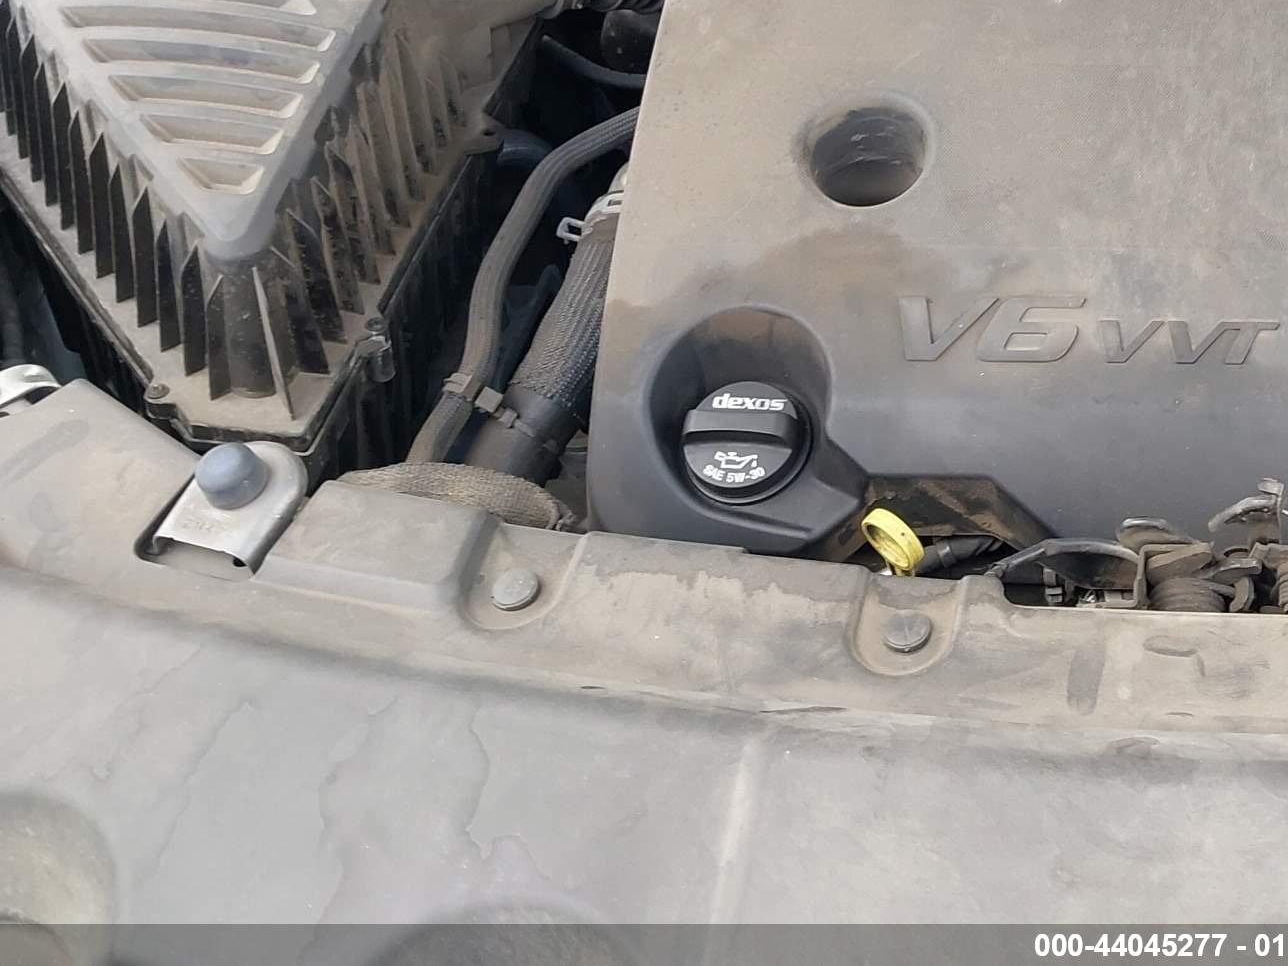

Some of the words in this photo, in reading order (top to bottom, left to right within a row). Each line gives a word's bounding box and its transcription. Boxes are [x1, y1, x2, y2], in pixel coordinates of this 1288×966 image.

[897, 297, 1086, 362] V6
[1098, 319, 1281, 365] VVT
[712, 393, 789, 410] dexos
[703, 464, 725, 481] SAE
[725, 466, 766, 483] 5W-30
